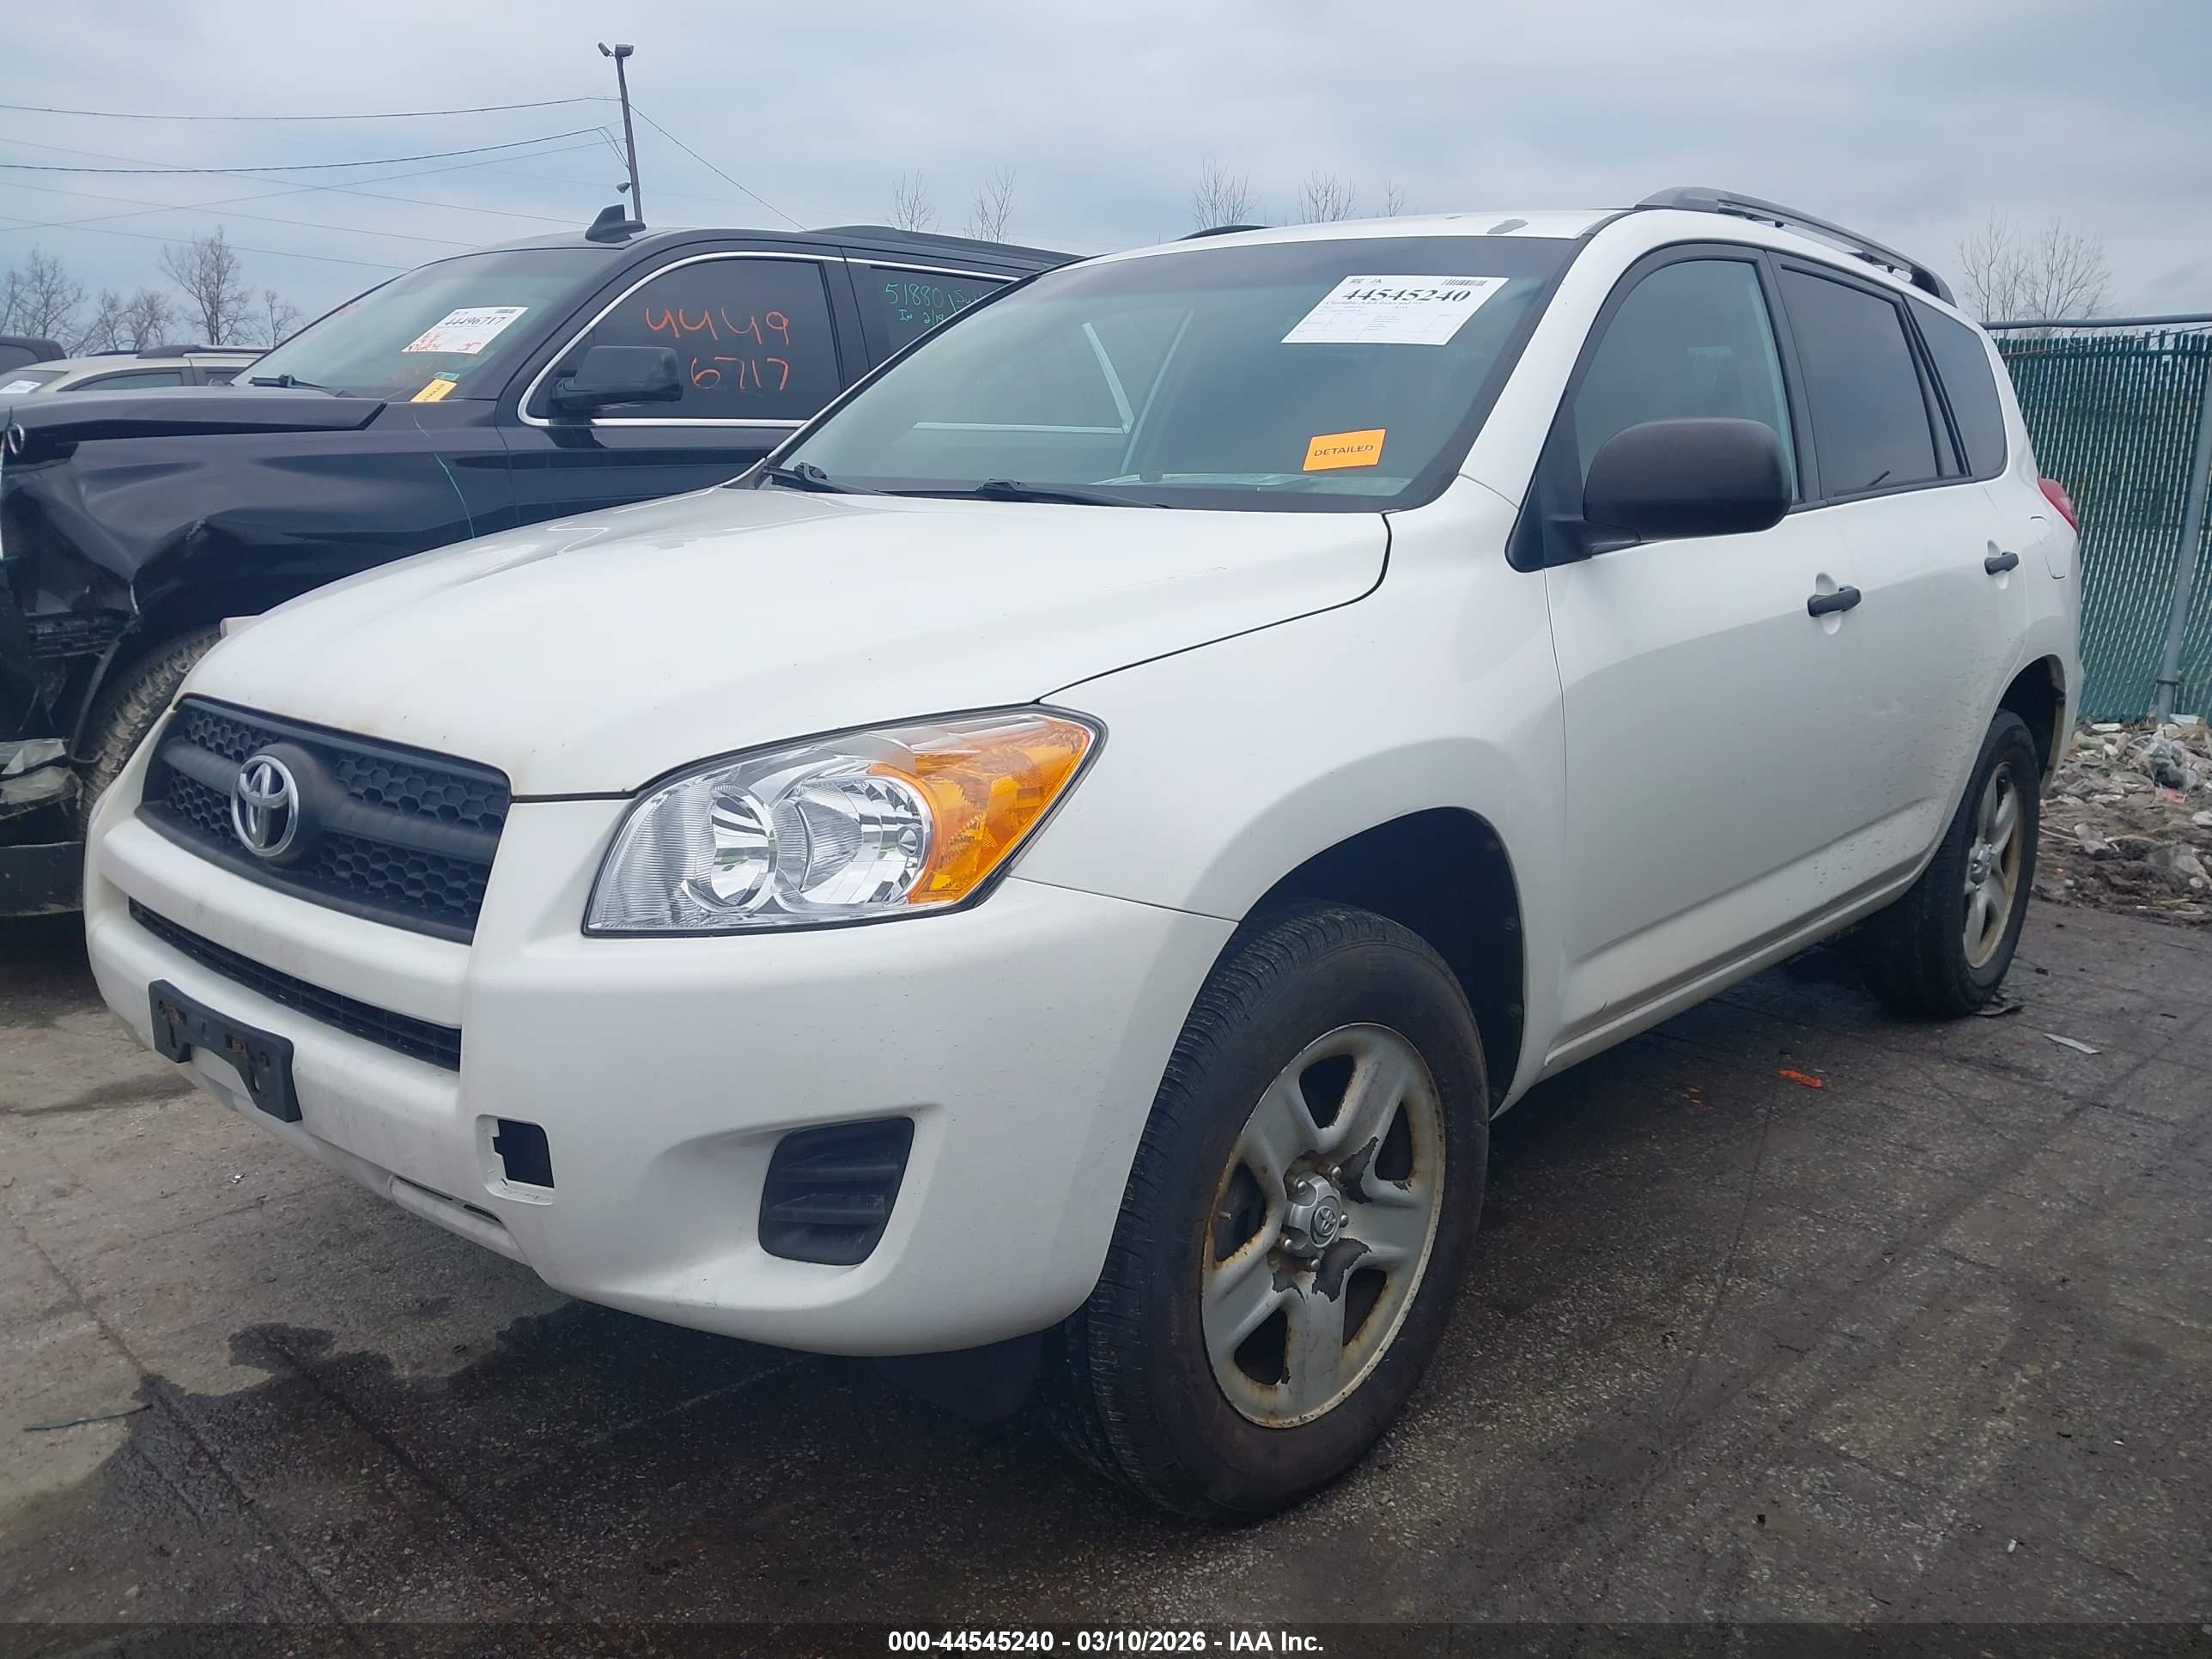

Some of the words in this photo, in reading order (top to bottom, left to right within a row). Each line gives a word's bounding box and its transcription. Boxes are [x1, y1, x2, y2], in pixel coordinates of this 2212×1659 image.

[885, 283, 945, 307] 51880
[1341, 289, 1471, 301] 44545240
[445, 316, 507, 325] 44496717
[646, 307, 790, 345] 4449
[690, 356, 790, 391] 6717
[1314, 443, 1374, 457] DETAILED
